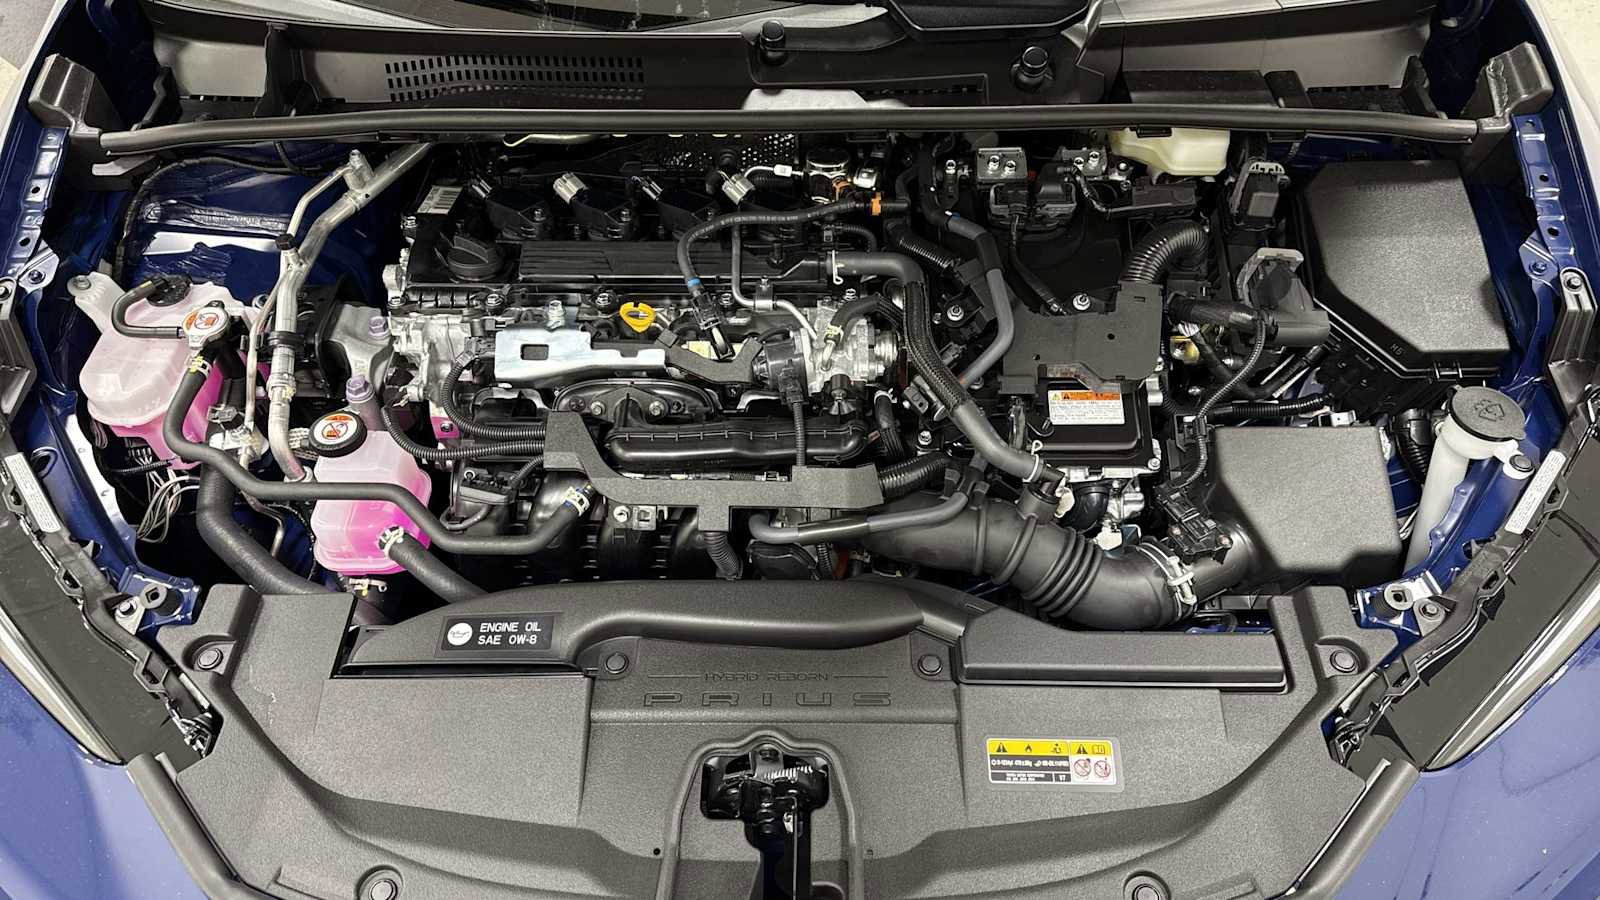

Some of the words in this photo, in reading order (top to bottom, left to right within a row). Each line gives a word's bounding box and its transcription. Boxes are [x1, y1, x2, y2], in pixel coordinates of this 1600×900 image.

[479, 621, 519, 633] ENGINE
[525, 621, 542, 632] OIL
[477, 634, 502, 645] SAE
[508, 634, 538, 645] 0W-8
[705, 672, 759, 681] HYBRID
[766, 672, 829, 681] REBORN
[643, 692, 892, 707] PRIUS
